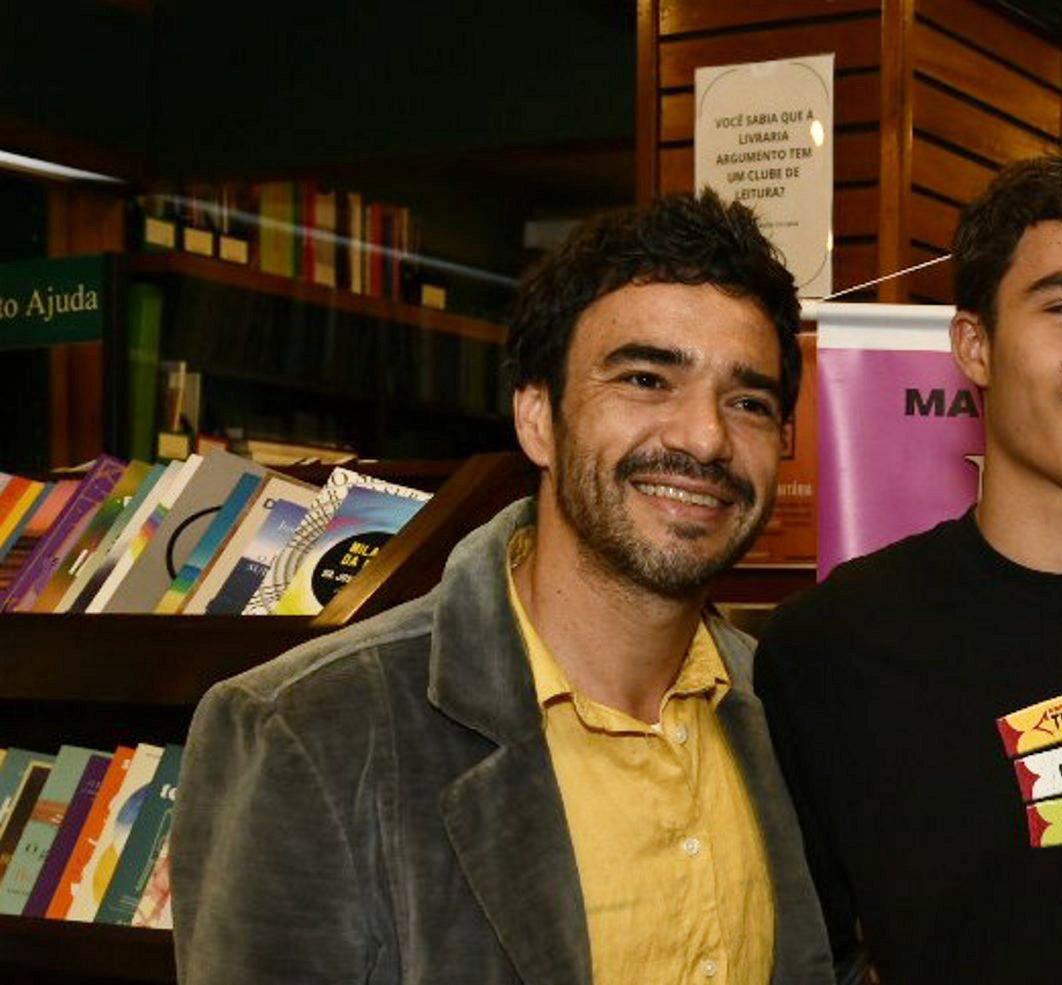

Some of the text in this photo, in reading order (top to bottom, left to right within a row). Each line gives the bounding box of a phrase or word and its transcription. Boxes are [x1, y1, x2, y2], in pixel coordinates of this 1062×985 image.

[715, 110, 814, 129] VOCÊ SABIA QUE A
[739, 131, 789, 145] LIVRARIA
[716, 147, 813, 166] ARGUMENTO TEM
[727, 166, 800, 183] UM CLUBE DE
[735, 186, 785, 201] LEITURA?
[25, 283, 98, 322] Ajuda
